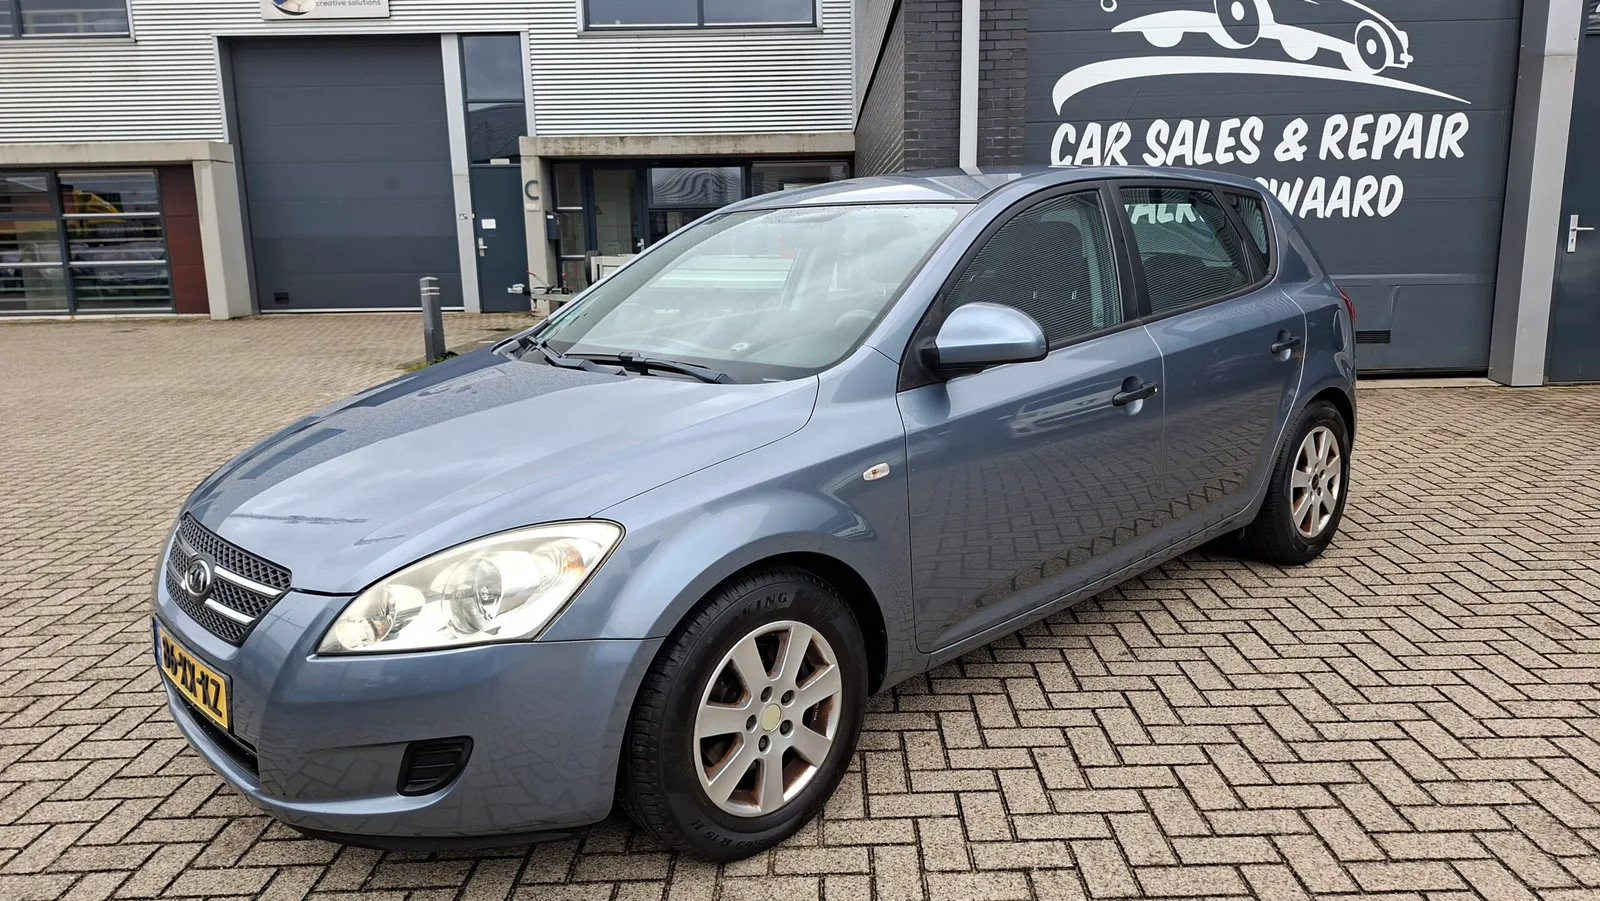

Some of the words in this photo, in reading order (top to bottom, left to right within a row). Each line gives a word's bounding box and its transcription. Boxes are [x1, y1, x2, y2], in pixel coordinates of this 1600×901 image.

[1050, 120, 1132, 166] CAR
[1142, 116, 1264, 167] SALES
[1273, 117, 1309, 162] &
[1318, 111, 1470, 161] REPAIR
[524, 179, 539, 200] C
